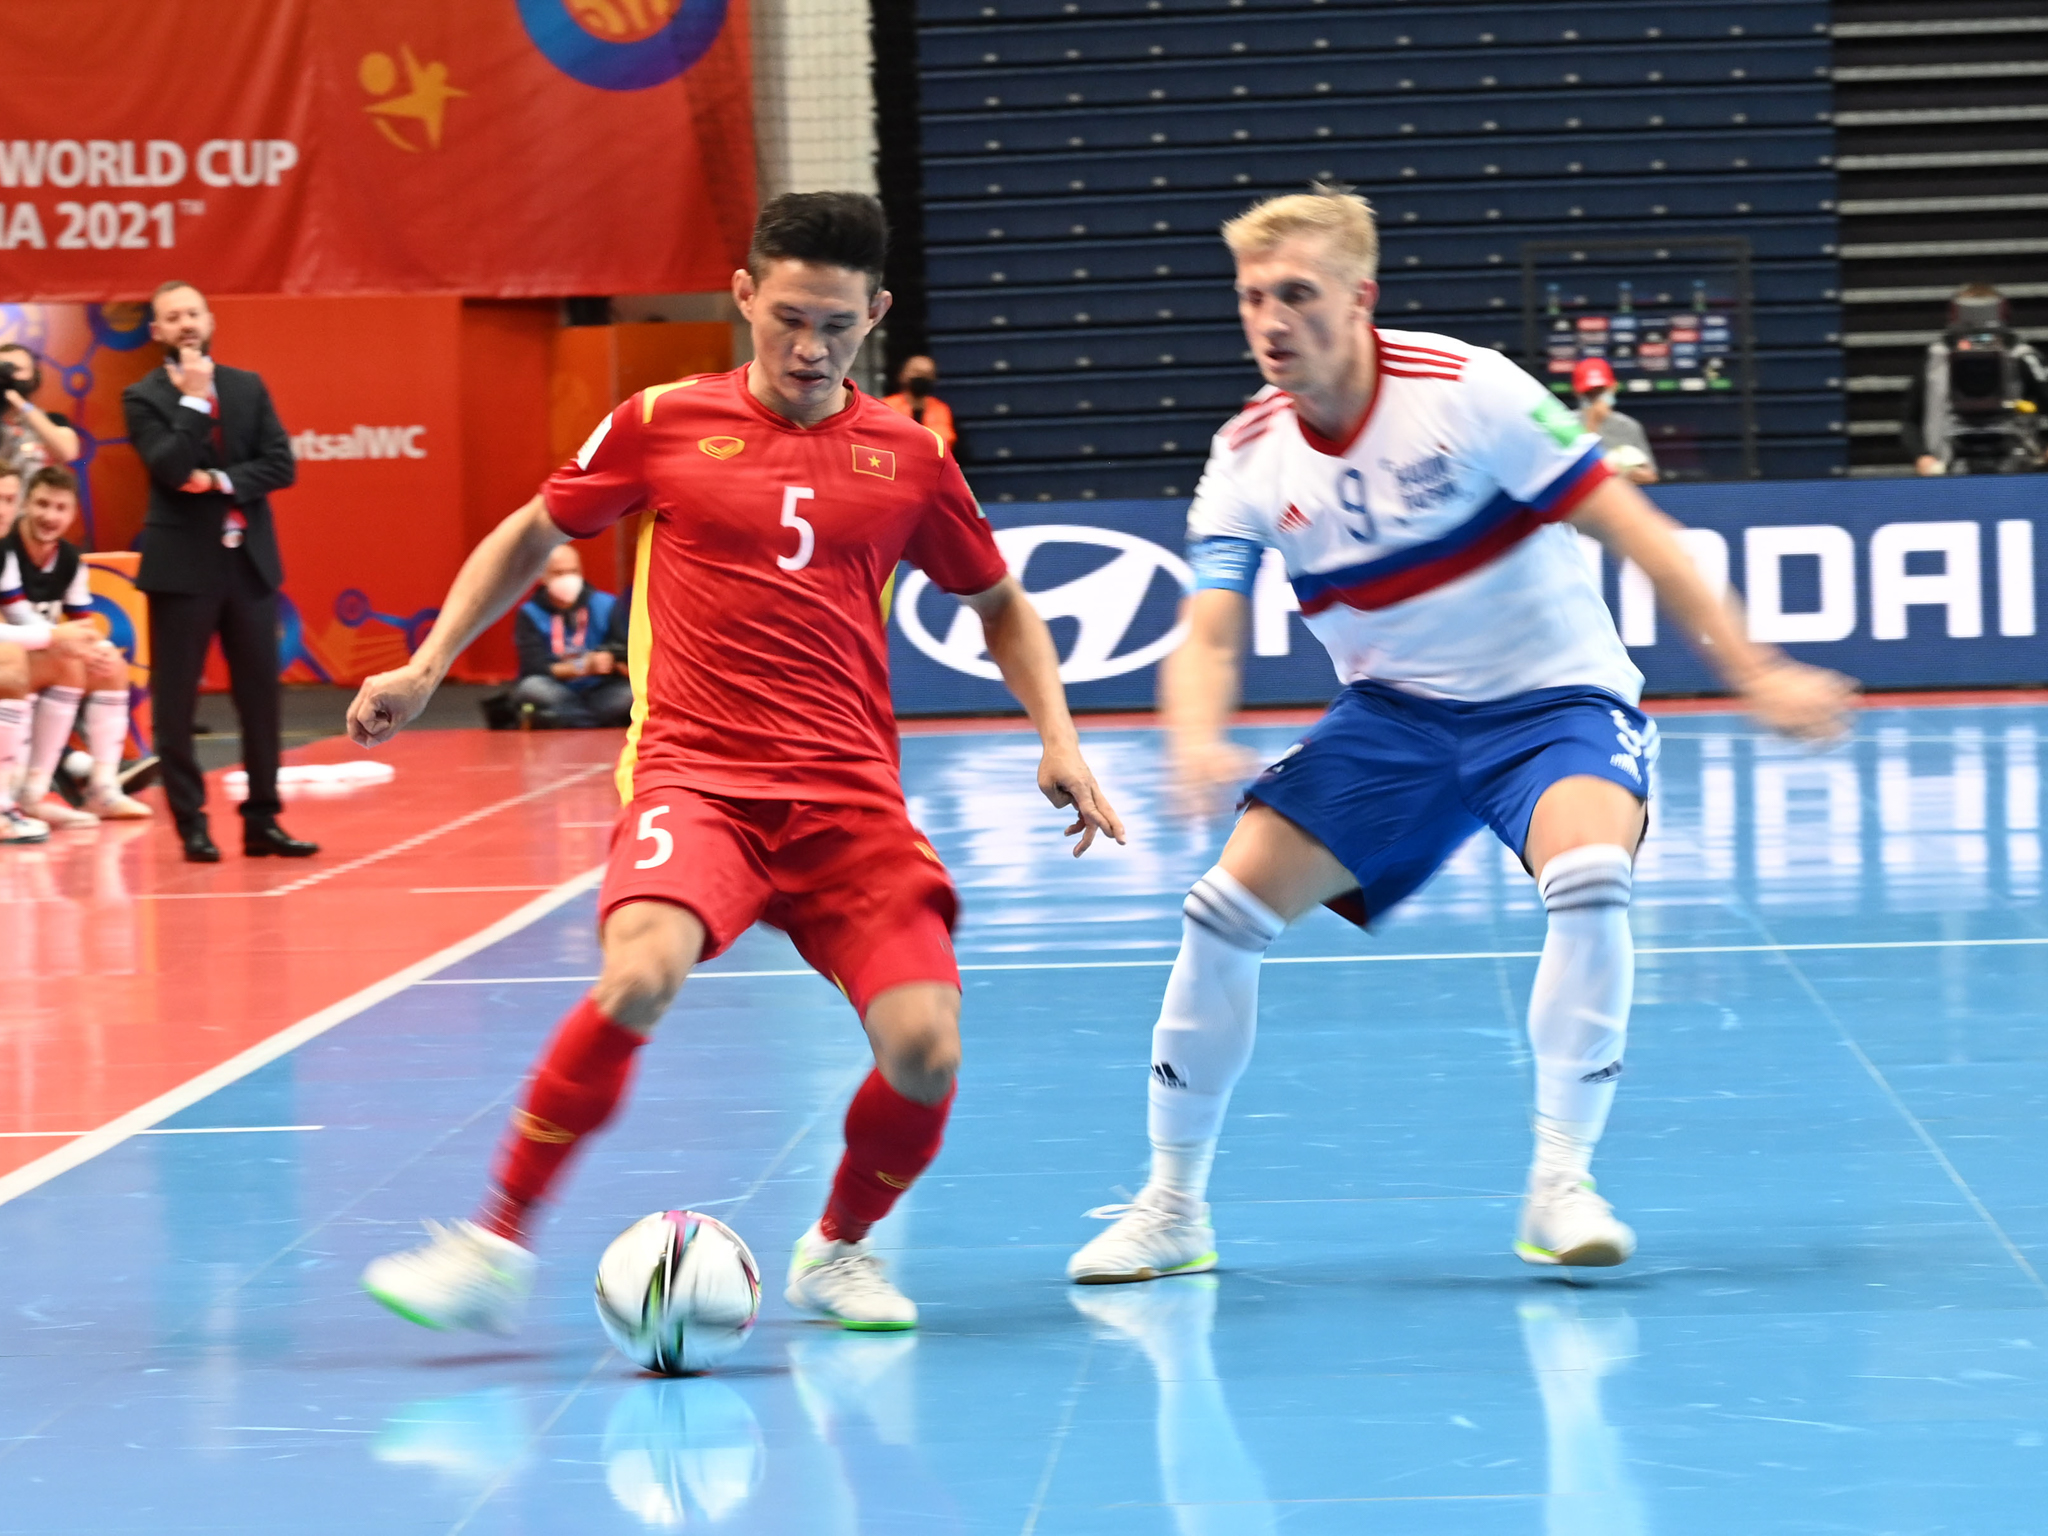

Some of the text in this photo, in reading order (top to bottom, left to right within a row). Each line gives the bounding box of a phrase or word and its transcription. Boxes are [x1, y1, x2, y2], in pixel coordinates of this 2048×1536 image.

[0, 138, 299, 188] WORLD CUP
[776, 485, 815, 571] 5
[1337, 466, 1377, 544] 9
[634, 805, 673, 870] 5
